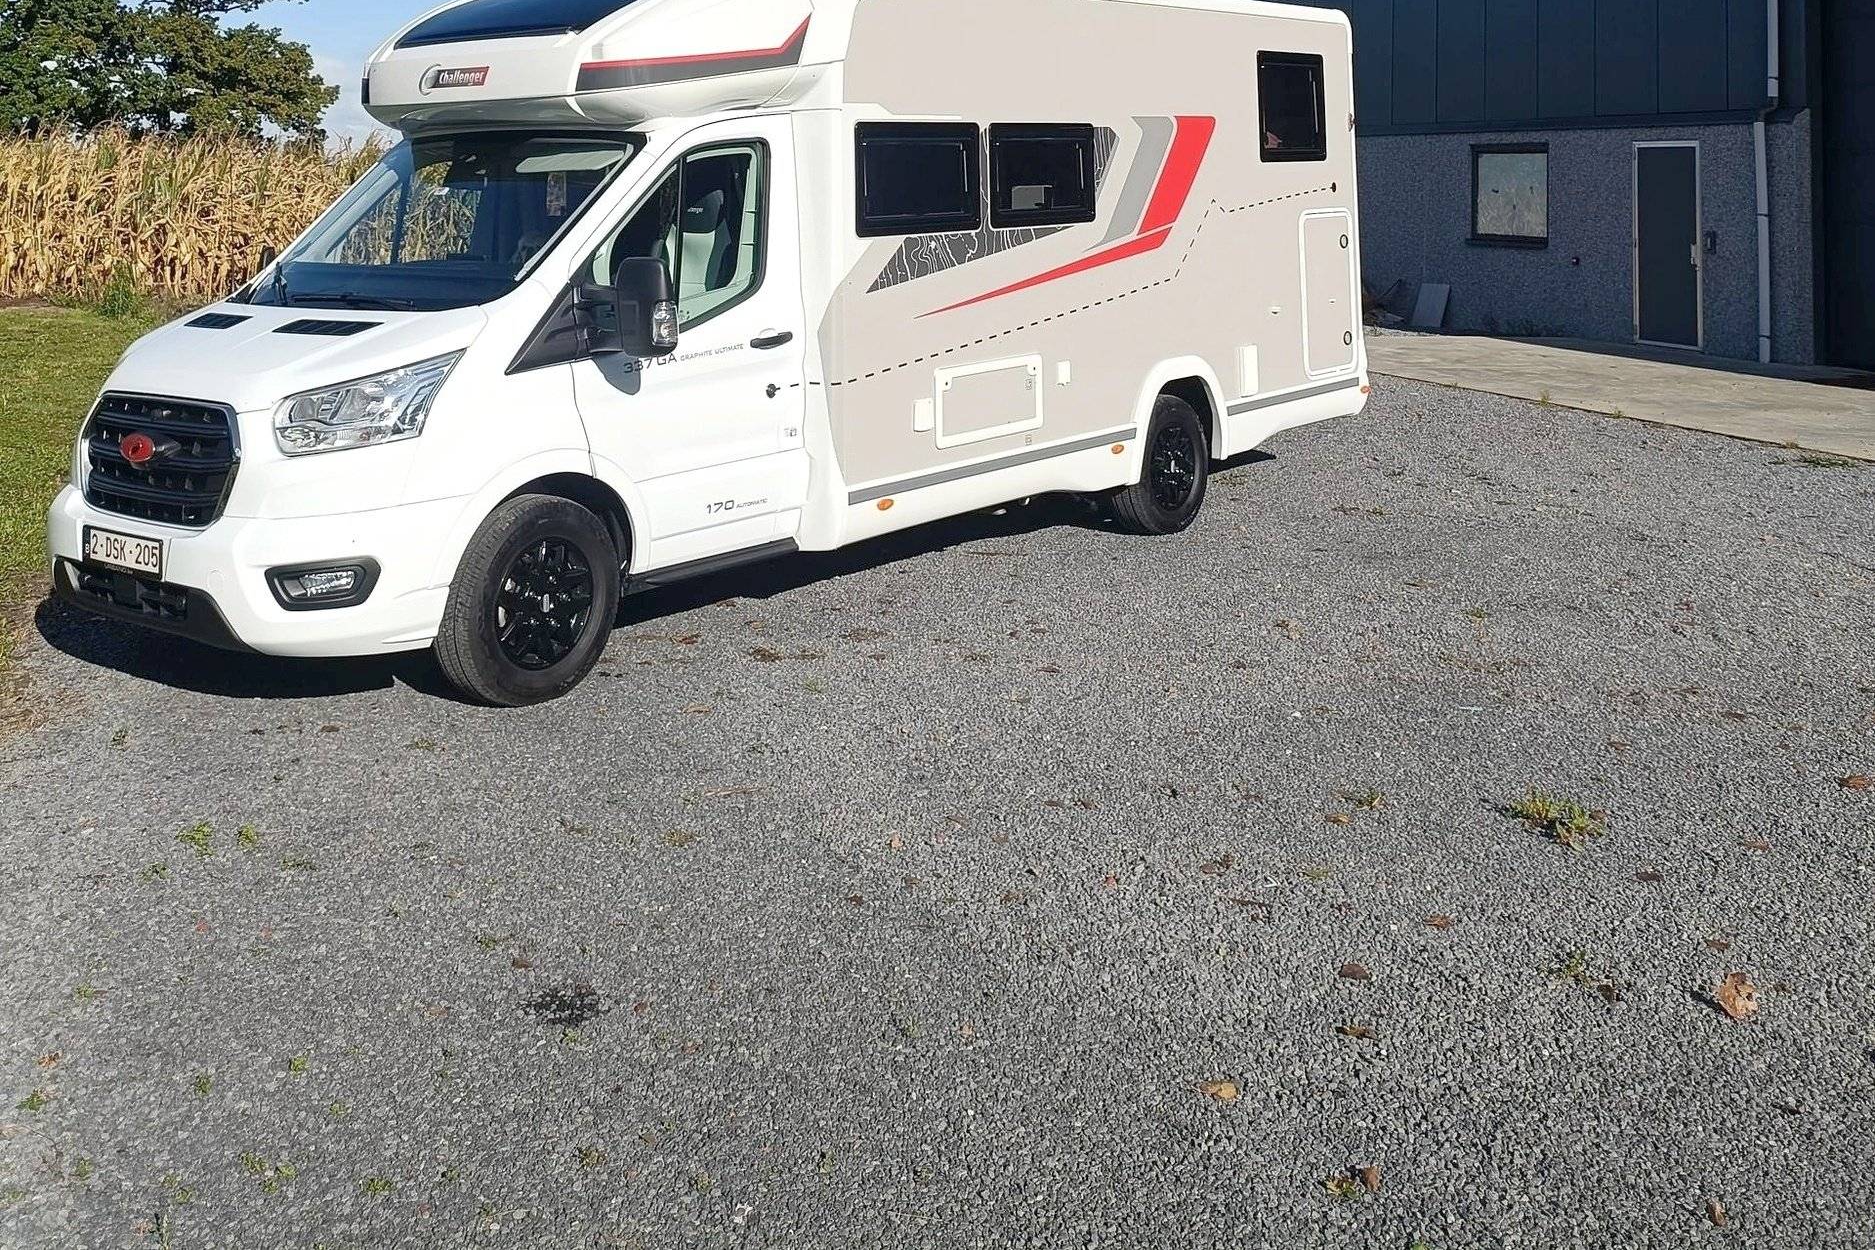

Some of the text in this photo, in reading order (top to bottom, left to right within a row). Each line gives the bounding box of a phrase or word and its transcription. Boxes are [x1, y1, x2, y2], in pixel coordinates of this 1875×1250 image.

[439, 69, 485, 86] Challenger
[623, 343, 744, 373] 337 GA GRAPHITE ULTIMATE
[706, 499, 735, 514] 170
